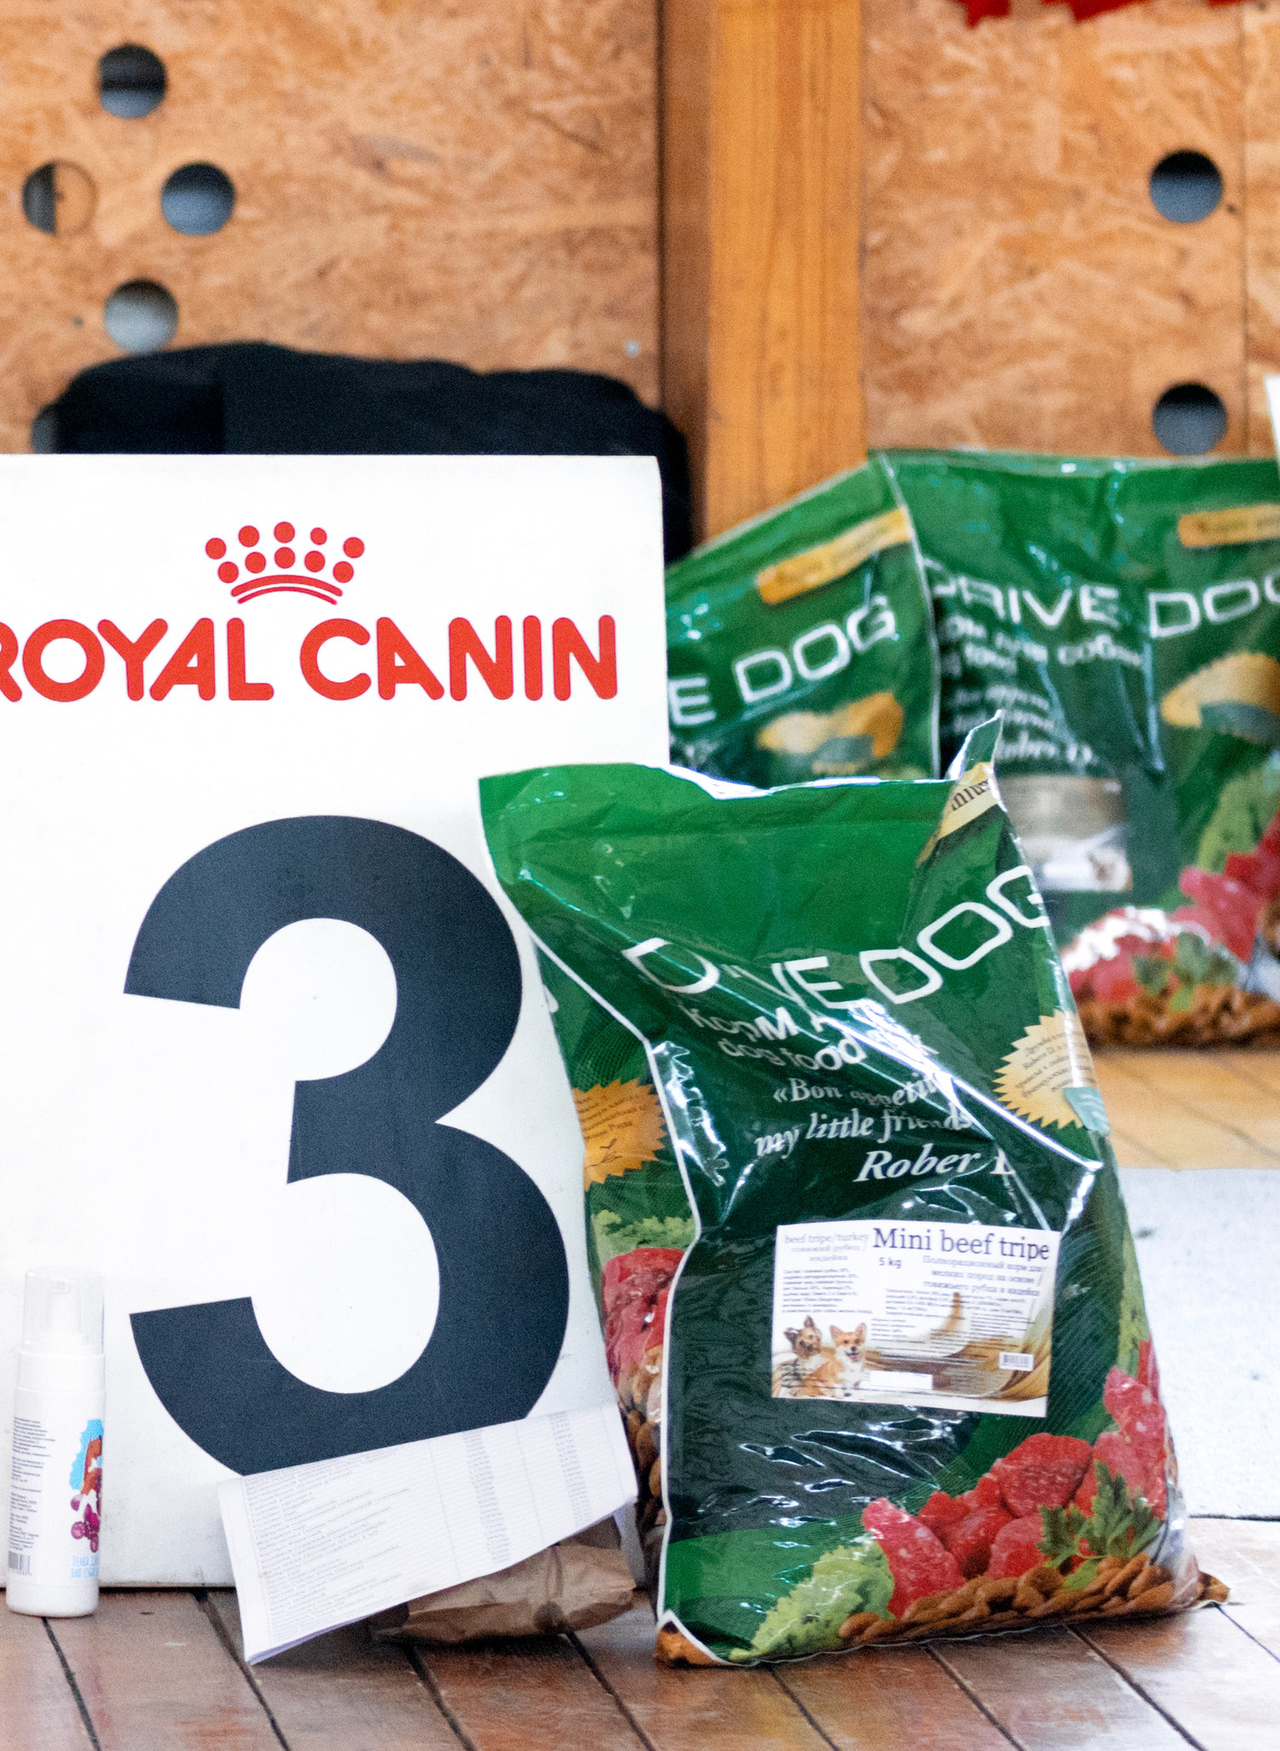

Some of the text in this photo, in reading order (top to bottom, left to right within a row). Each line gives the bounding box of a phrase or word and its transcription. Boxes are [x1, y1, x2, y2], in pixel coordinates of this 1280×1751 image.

[300, 614, 618, 701] CANIN
[734, 595, 898, 704] DOG
[859, 865, 1051, 1004] DOG
[123, 814, 570, 1476] 3
[806, 1107, 875, 1139] little
[853, 1142, 982, 1183] Rober
[872, 1227, 1050, 1261] Mini beef tripe
[878, 1256, 902, 1269] 5 kg
